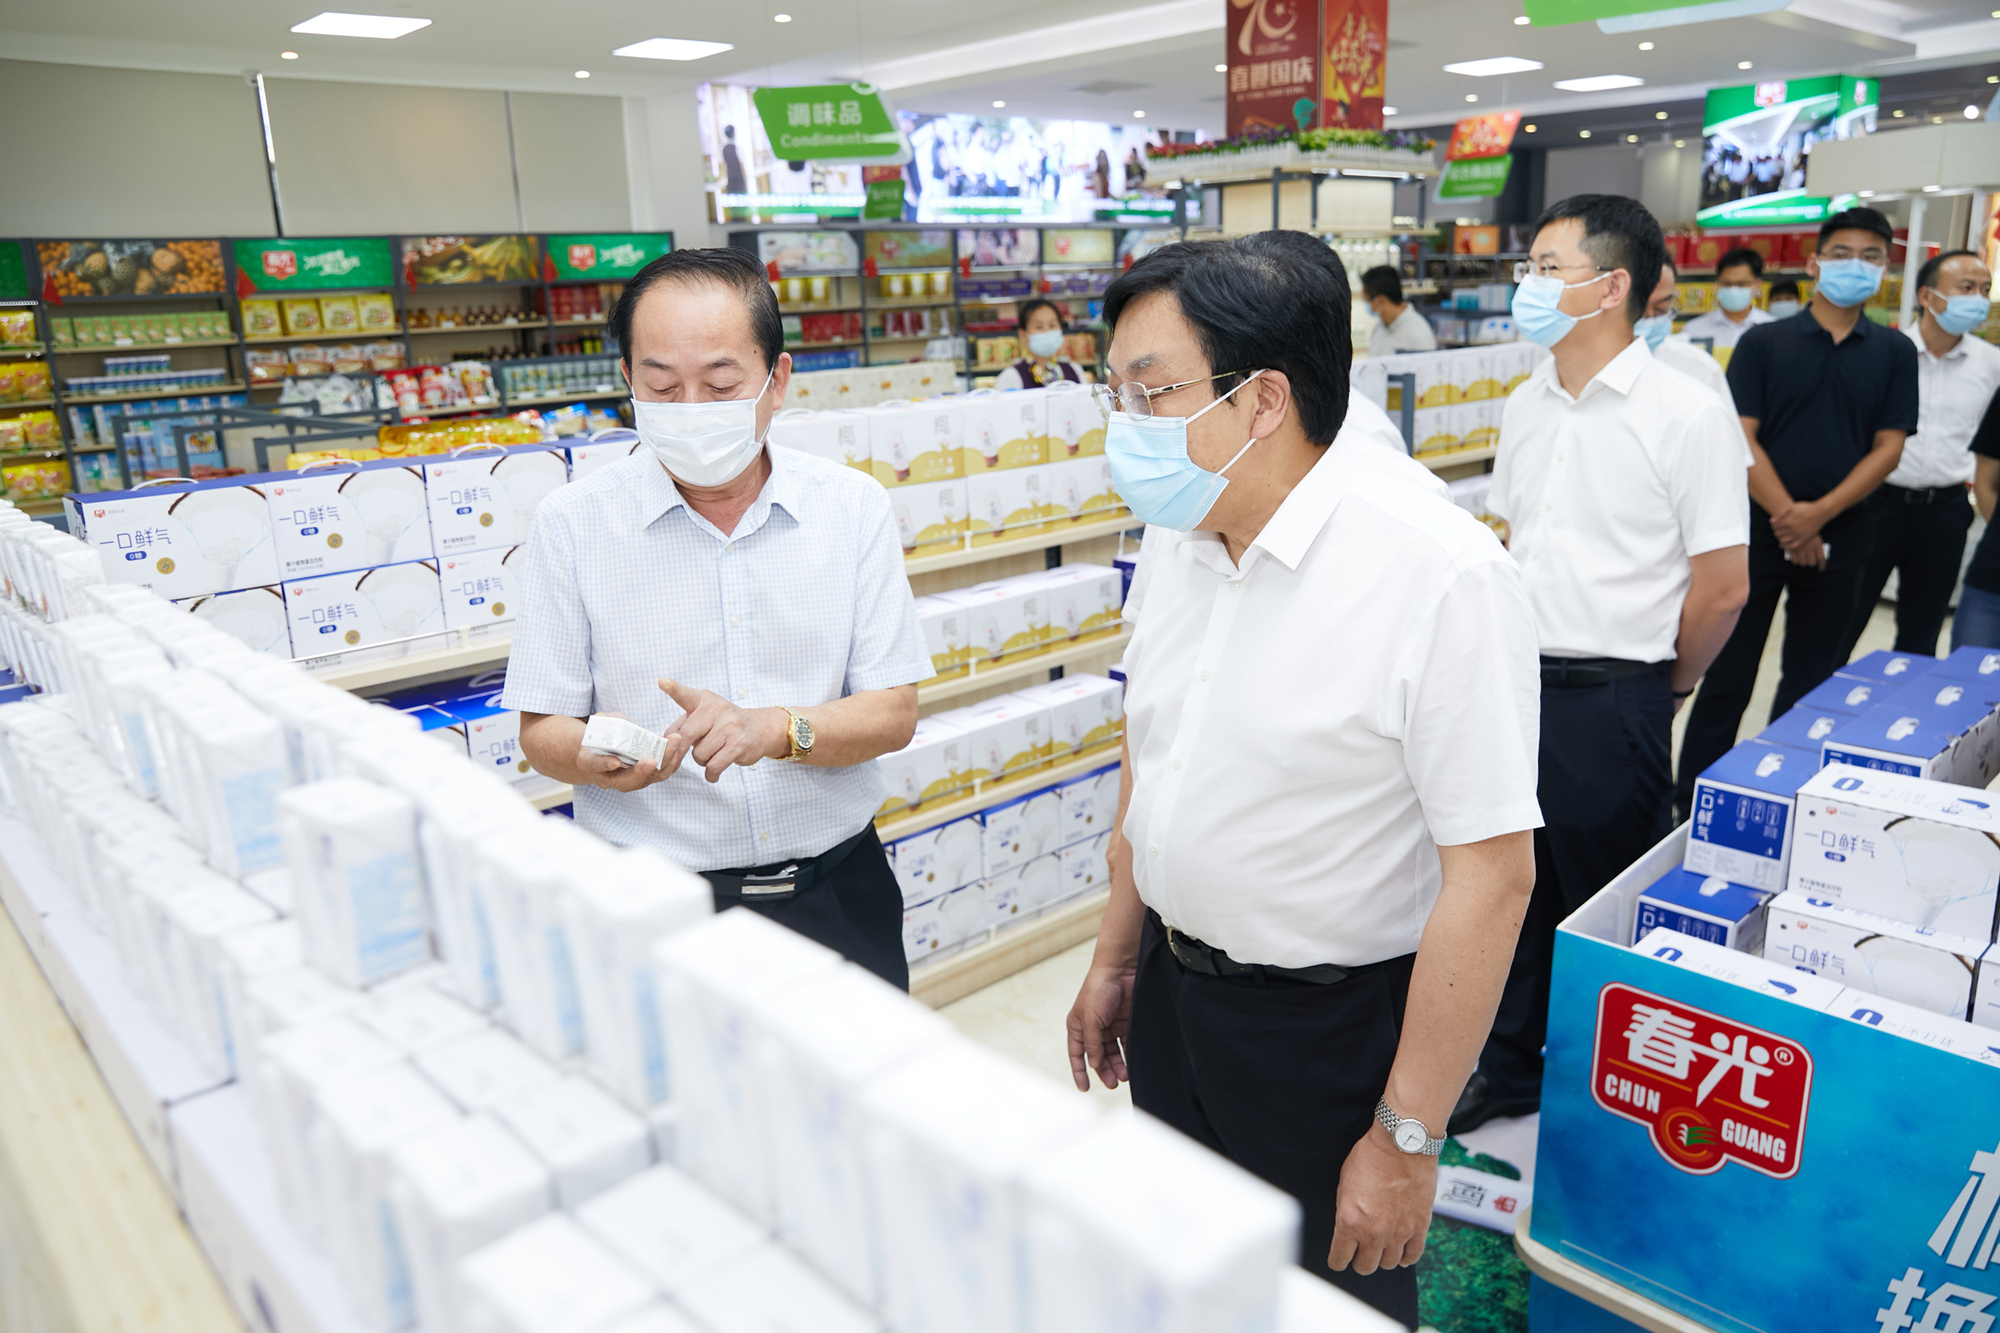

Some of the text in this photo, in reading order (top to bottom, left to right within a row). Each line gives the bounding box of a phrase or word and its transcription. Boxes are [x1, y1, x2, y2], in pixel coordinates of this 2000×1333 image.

[786, 100, 862, 127] 调味品
[780, 130, 870, 149] Condiments
[278, 504, 341, 526] 一口鲜气
[99, 527, 172, 550] 一口鲜气
[297, 602, 358, 624] 一口鲜气
[1804, 829, 1876, 859] 一口鲜气
[1775, 943, 1846, 975] 一口鲜气
[1622, 1002, 1775, 1109] 春光
[1604, 1073, 1787, 1163] CHUN GUANG
